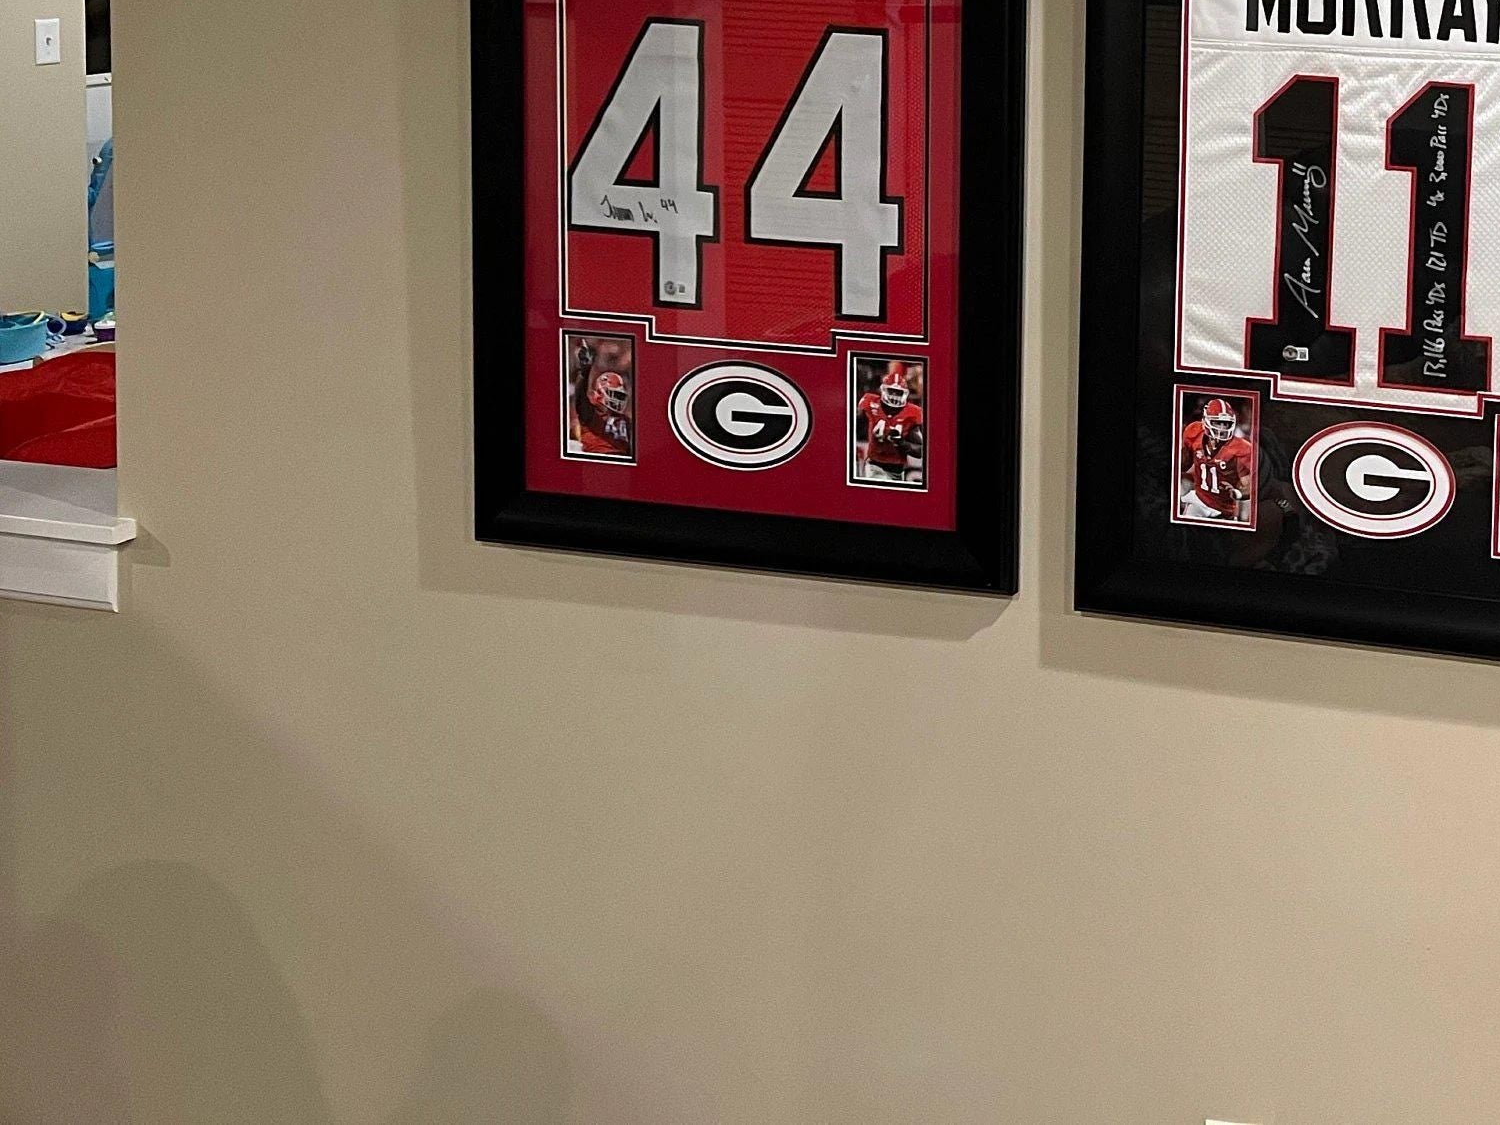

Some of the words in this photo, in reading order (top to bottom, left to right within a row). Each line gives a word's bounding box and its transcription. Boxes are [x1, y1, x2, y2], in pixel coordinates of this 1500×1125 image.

[567, 17, 905, 322] 44
[1244, 74, 1493, 395] 11
[1199, 463, 1221, 494] 11
[1318, 442, 1436, 516] G
